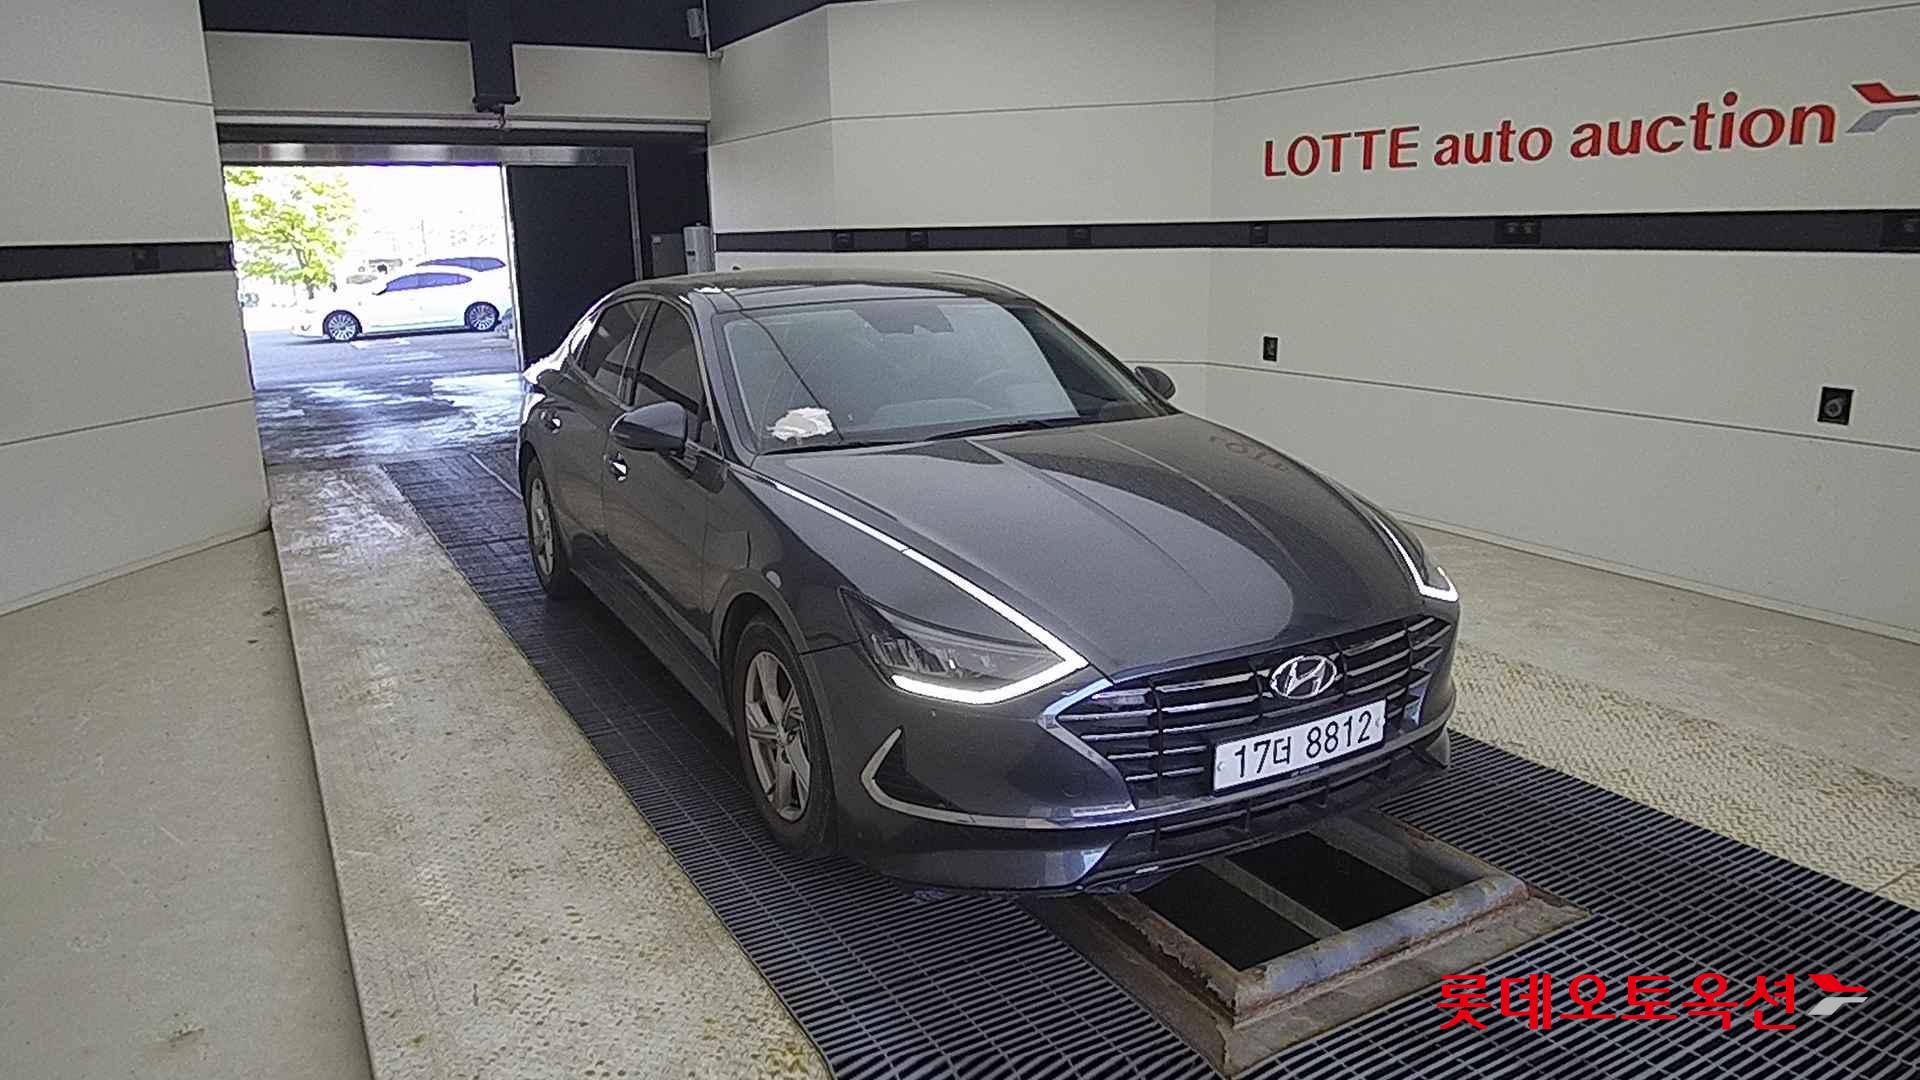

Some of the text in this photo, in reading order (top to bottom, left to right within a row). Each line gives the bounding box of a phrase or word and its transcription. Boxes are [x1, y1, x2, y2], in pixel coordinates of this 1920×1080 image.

[1265, 91, 1836, 177] LOTTE auto auction
[1234, 710, 1372, 777] 17더 8812
